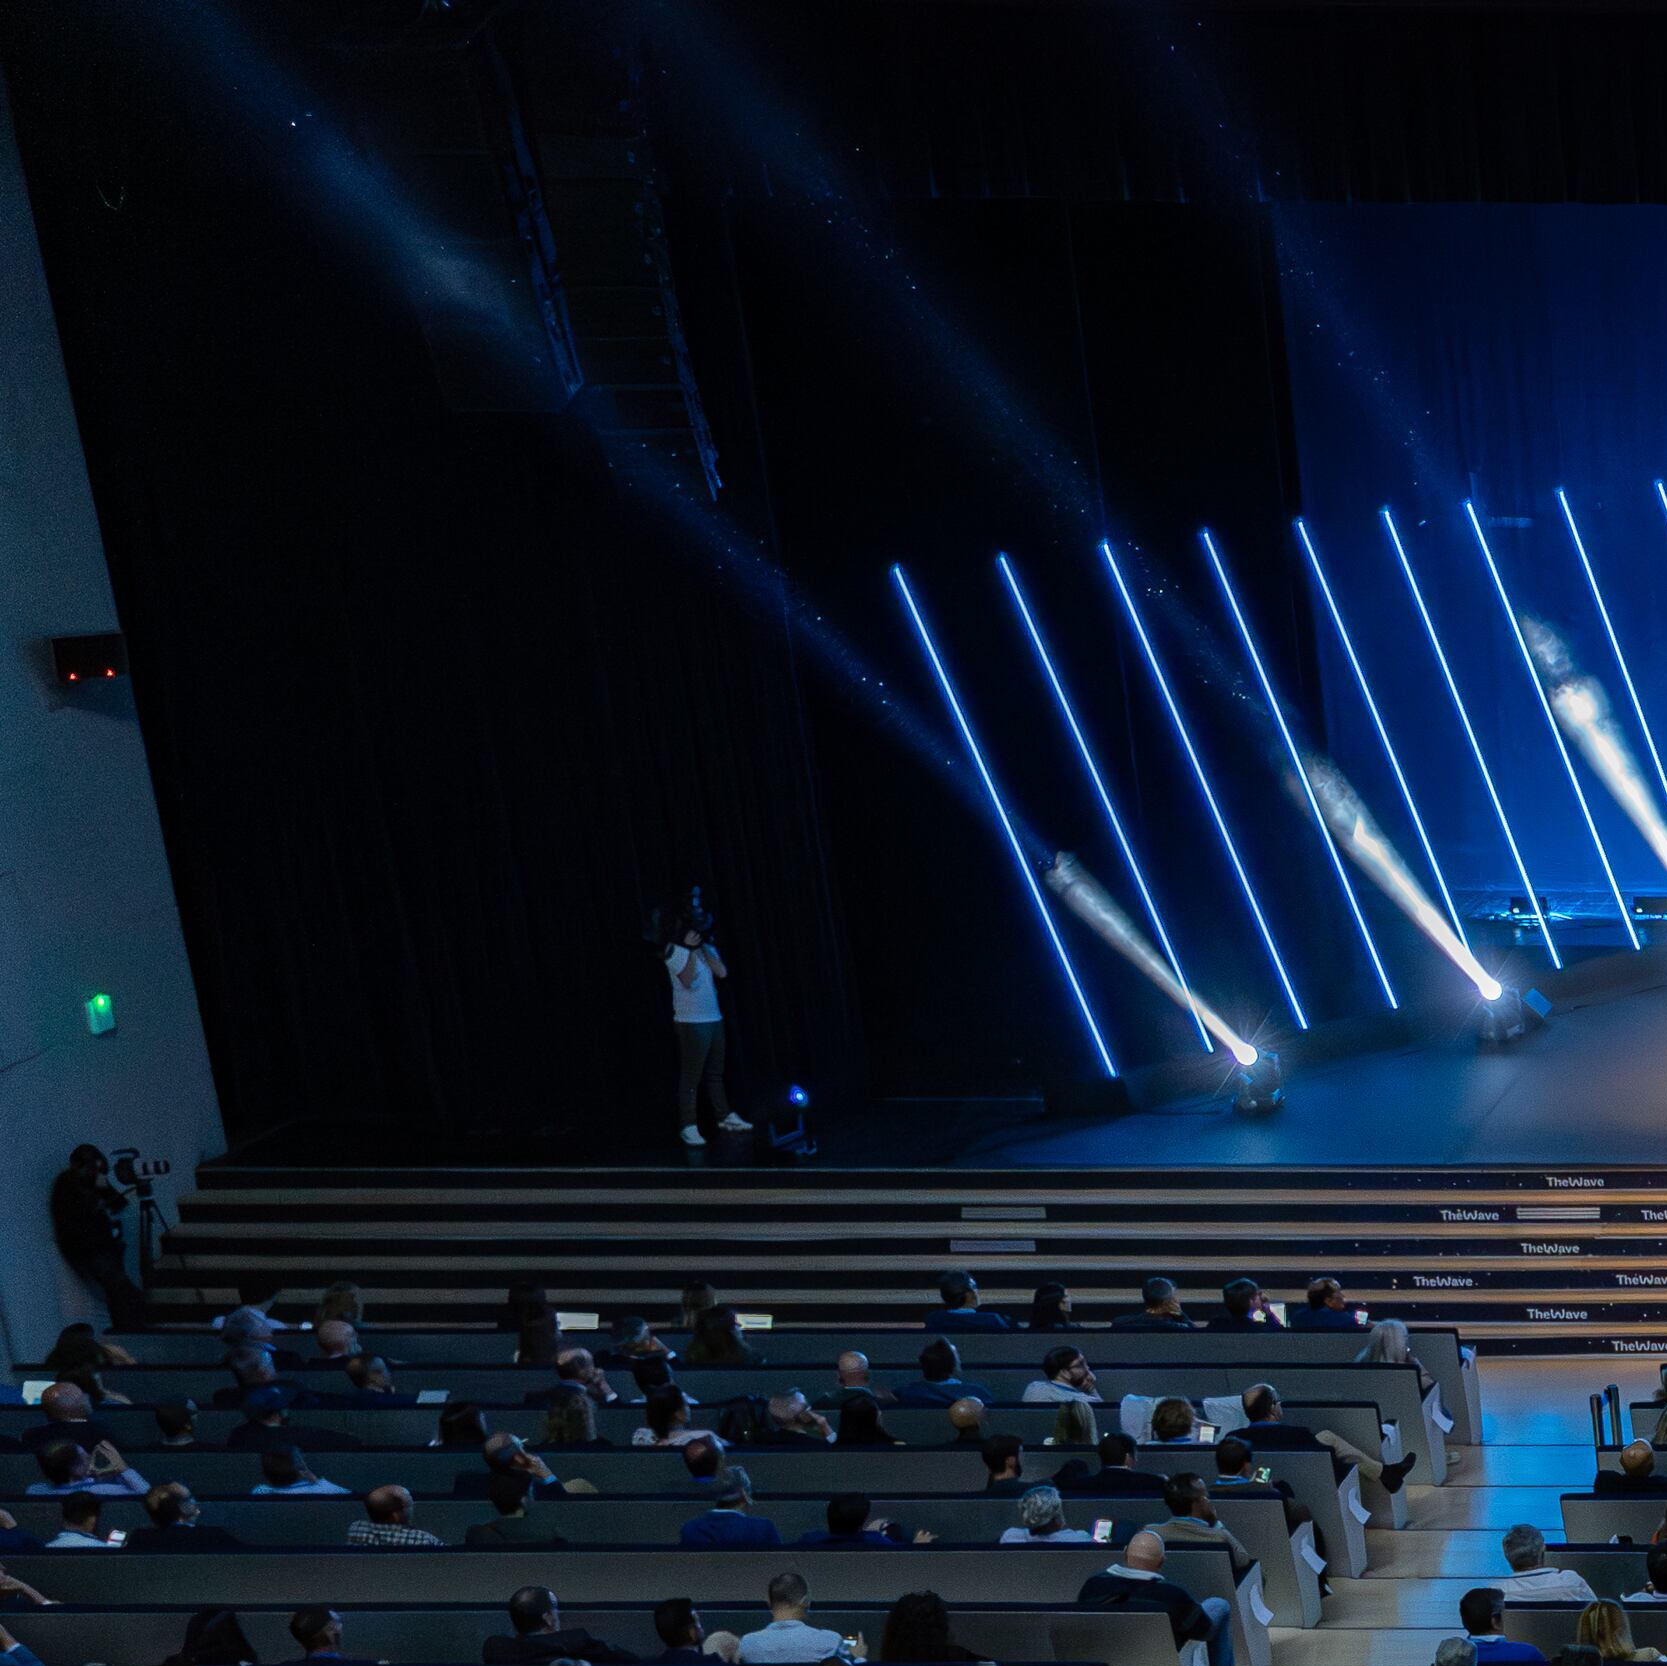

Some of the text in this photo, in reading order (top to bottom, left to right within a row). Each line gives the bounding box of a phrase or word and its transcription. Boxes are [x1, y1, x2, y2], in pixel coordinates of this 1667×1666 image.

[1546, 1176, 1604, 1187] TheWave
[1440, 1210, 1499, 1221] TheWave
[1521, 1243, 1580, 1254] TheWave
[1413, 1276, 1473, 1287] TheWave
[1527, 1308, 1587, 1319] TheWave
